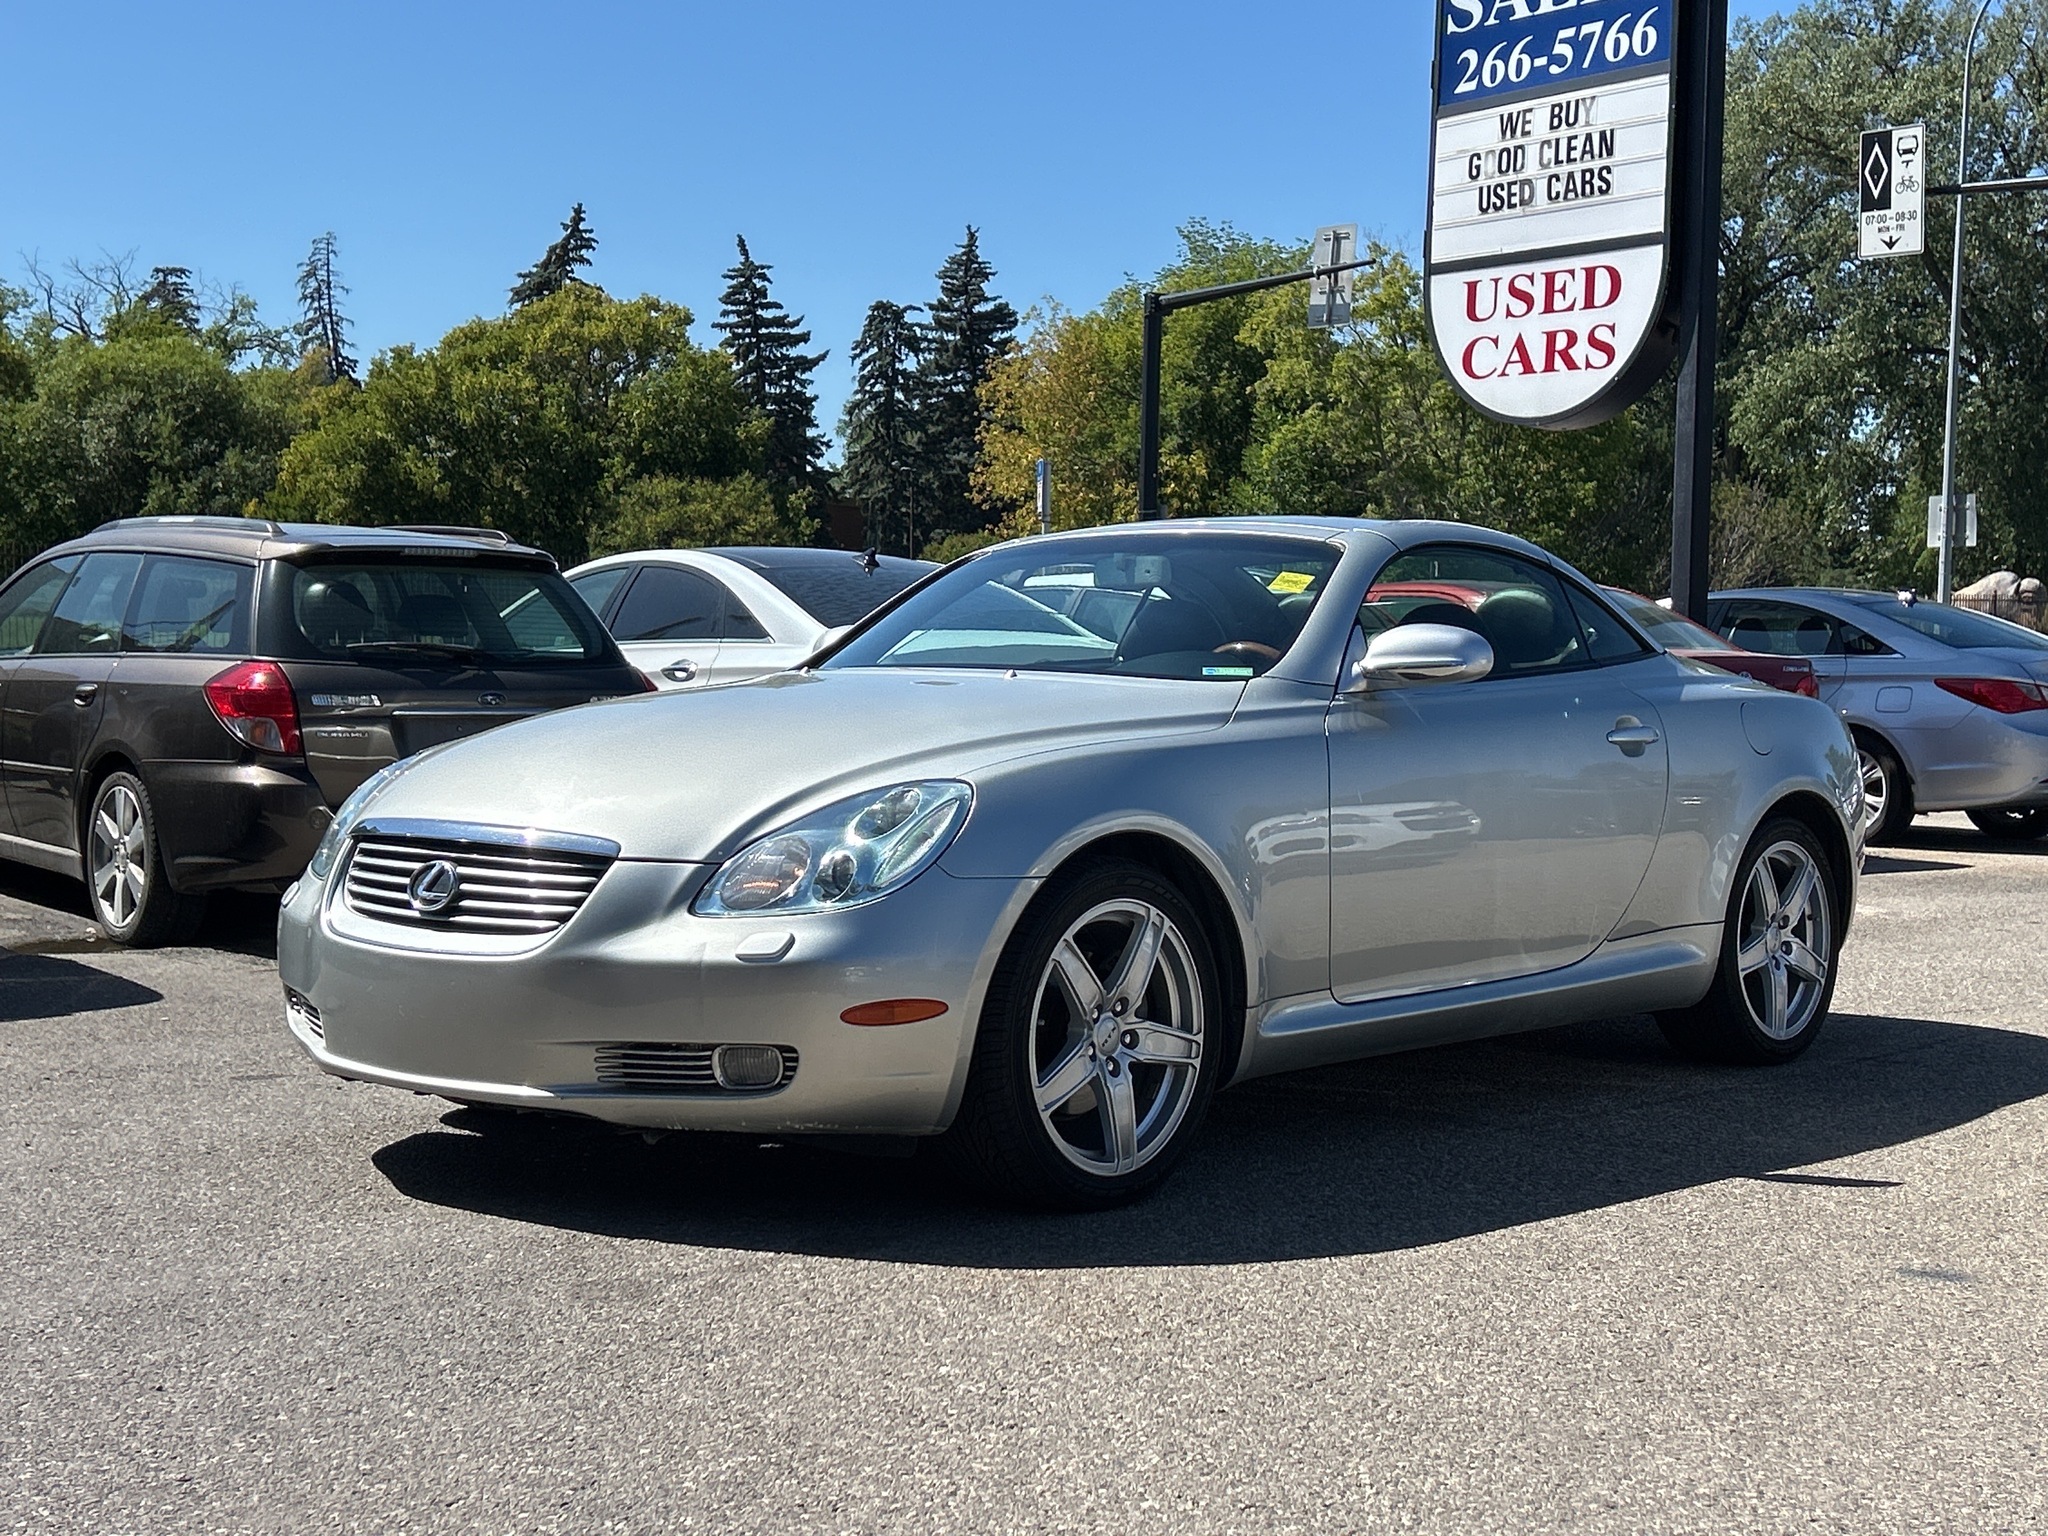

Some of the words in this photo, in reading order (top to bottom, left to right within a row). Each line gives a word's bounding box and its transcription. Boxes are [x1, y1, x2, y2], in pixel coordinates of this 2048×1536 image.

[1454, 6, 1659, 94] 266-5766
[1500, 108, 1533, 139] WE
[1549, 96, 1596, 130] BUY
[1469, 144, 1526, 180] GOOD
[1539, 129, 1615, 169] CLEAN
[1478, 178, 1535, 213] USED
[1547, 165, 1612, 201] CARS
[1463, 265, 1622, 322] USED
[1462, 323, 1616, 379] CARS
